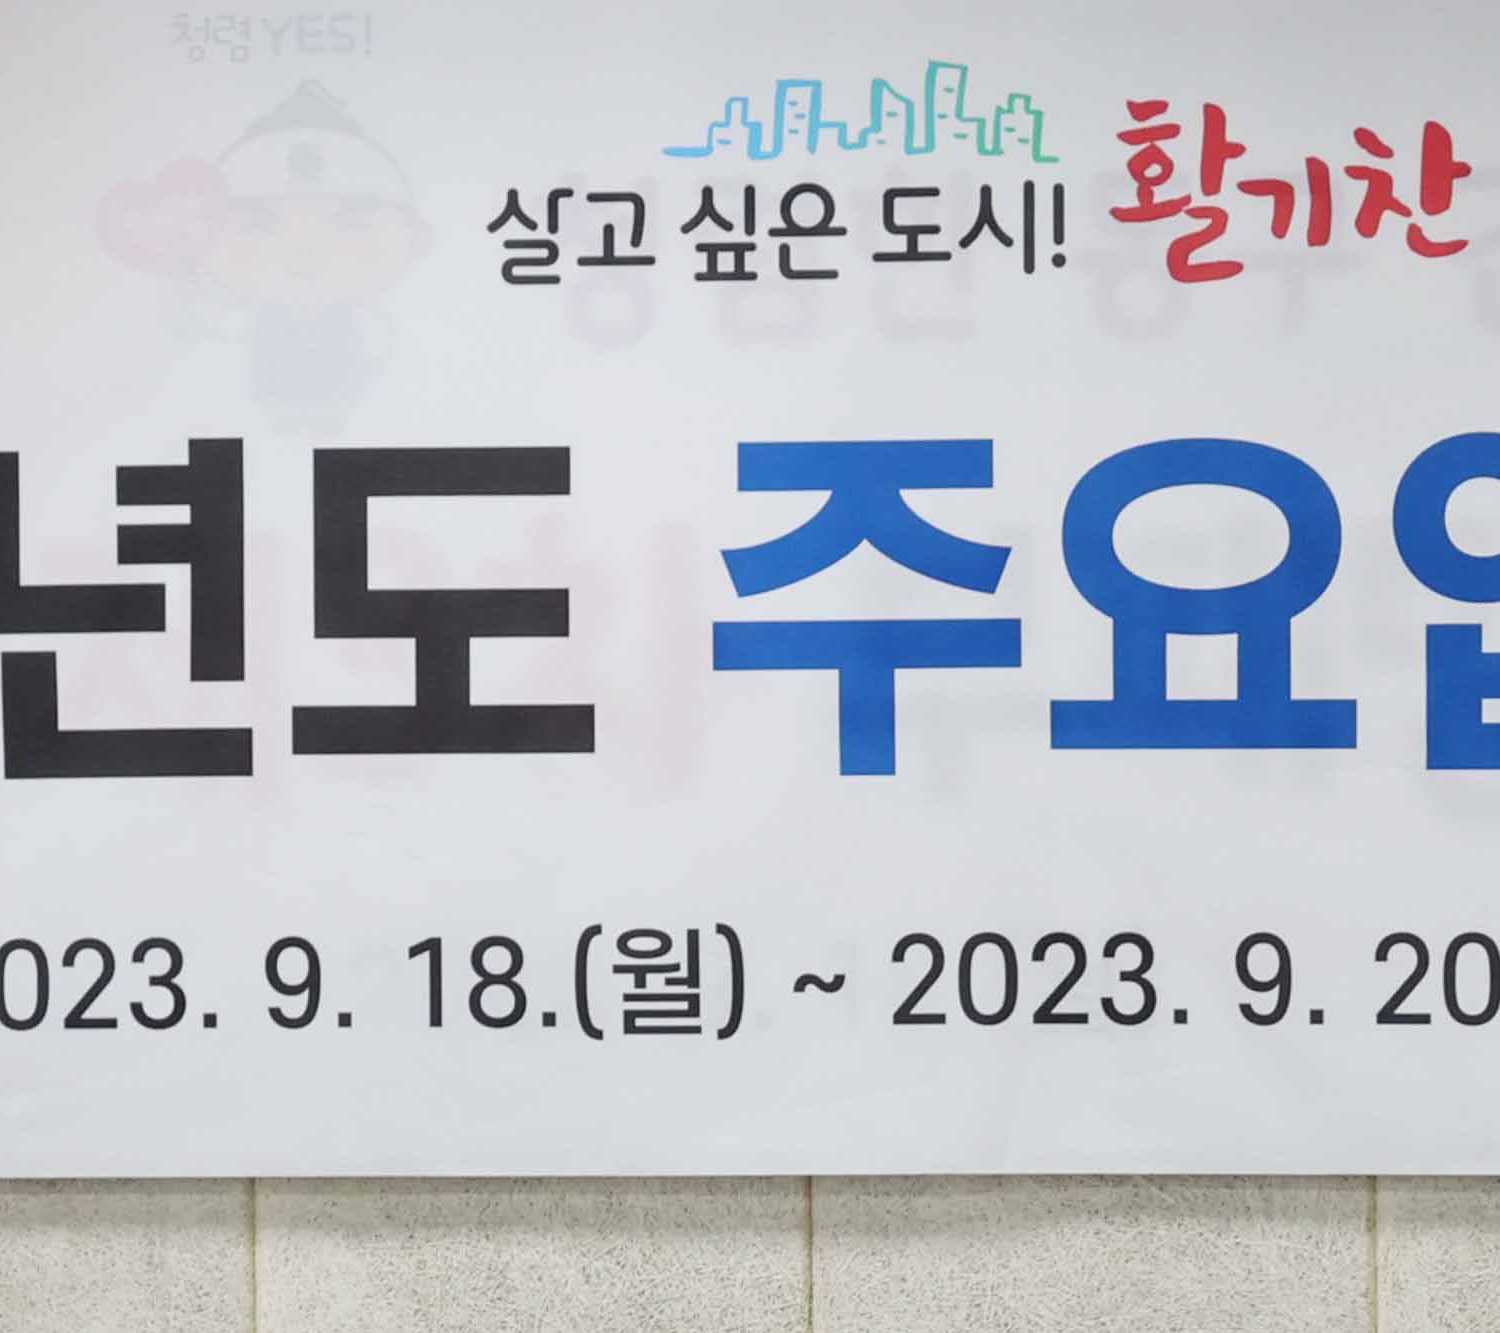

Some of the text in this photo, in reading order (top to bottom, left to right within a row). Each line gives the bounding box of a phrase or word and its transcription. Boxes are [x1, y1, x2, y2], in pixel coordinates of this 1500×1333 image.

[486, 187, 656, 285] 살고
[679, 183, 848, 282] 싶은
[871, 178, 1068, 275] 도시!
[1108, 99, 1474, 284] 활기찬
[265, 936, 352, 1029] 9.
[408, 923, 746, 1041] 18.(월)
[793, 972, 847, 994] ~
[891, 932, 1188, 1027] 2023.
[1235, 932, 1324, 1027] 9.
